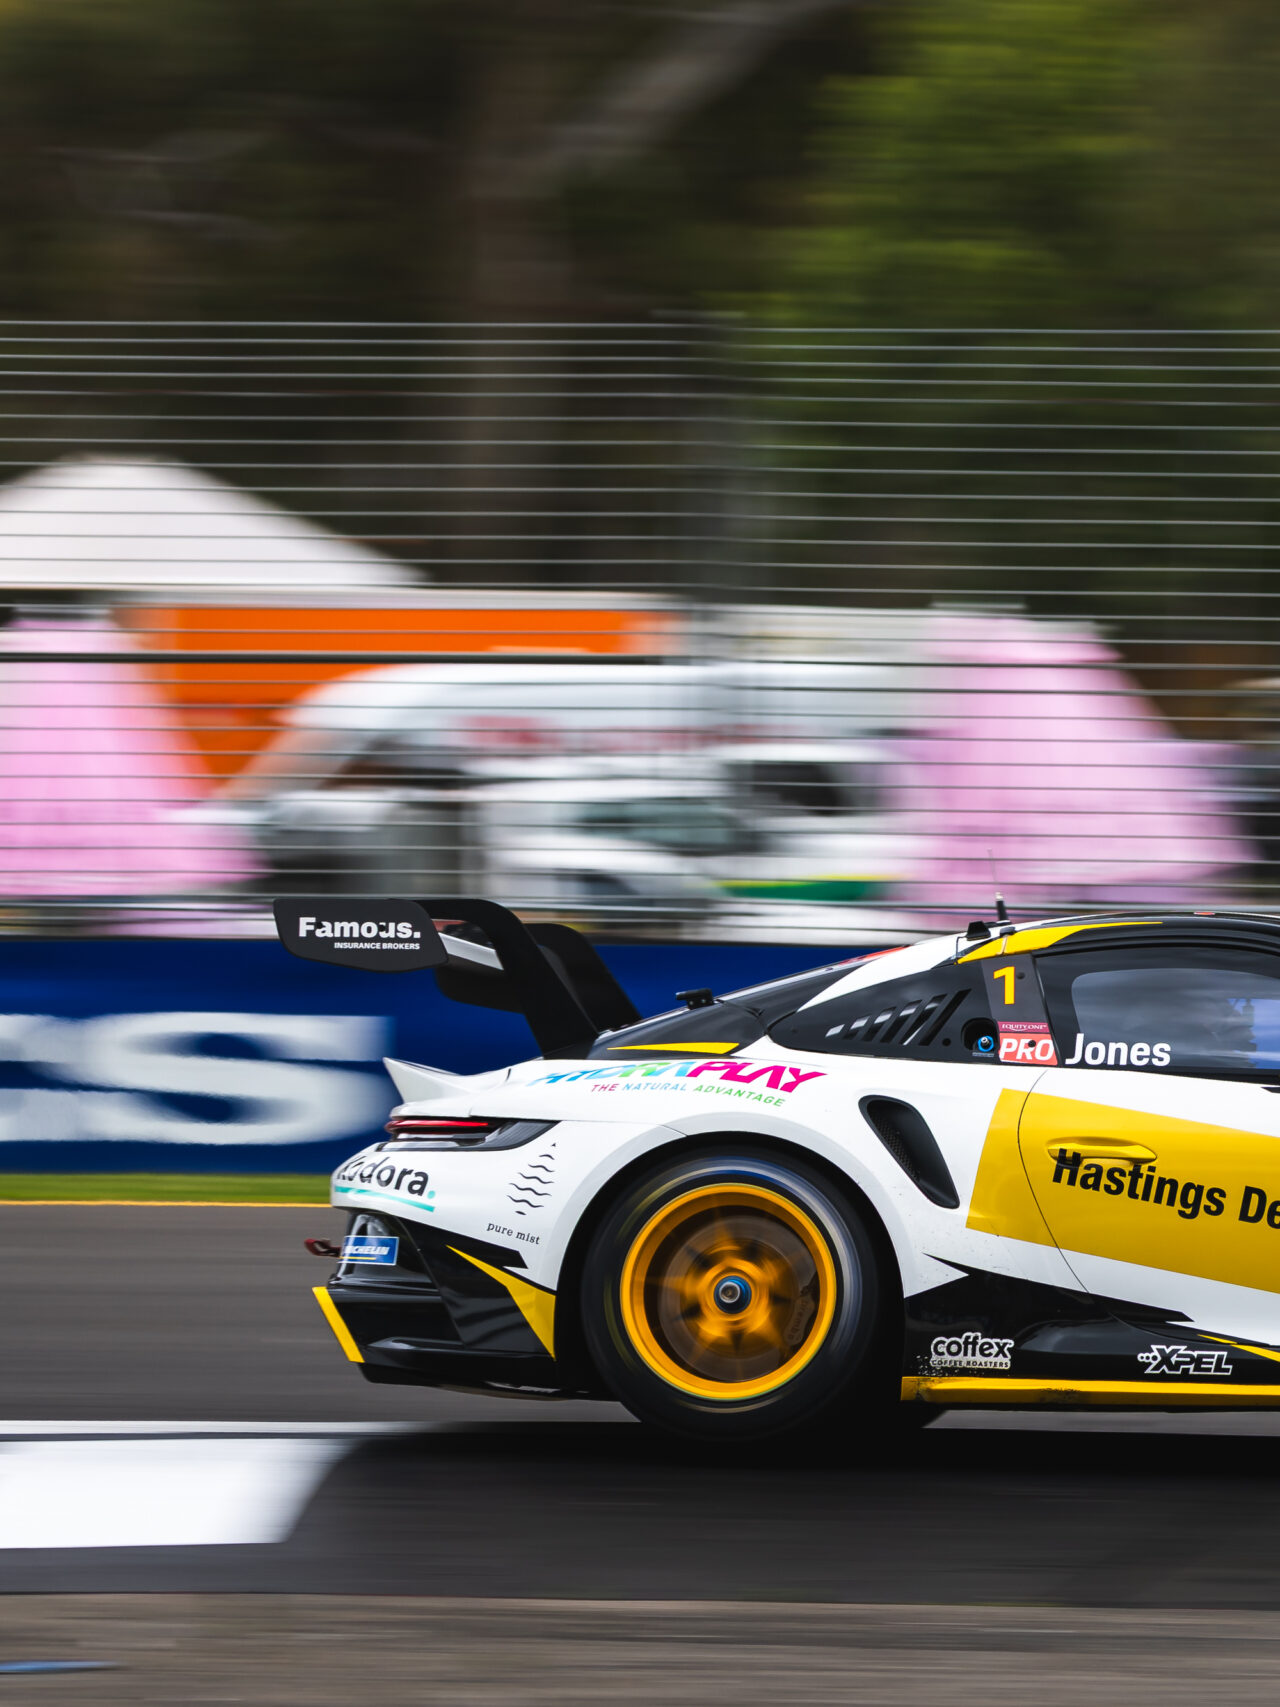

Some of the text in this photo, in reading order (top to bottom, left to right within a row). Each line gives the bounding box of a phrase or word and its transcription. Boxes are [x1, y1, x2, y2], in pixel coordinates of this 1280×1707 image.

[298, 916, 421, 938] Famous.
[993, 966, 1015, 1005] 1
[1000, 1038, 1054, 1061] PRO
[1065, 1033, 1171, 1067] Jones
[591, 1083, 787, 1107] THE NATURAL ADVANTAGE
[1052, 1149, 1227, 1219] Hastings
[487, 1222, 540, 1245] pure mist
[931, 1332, 1013, 1359] coffex
[931, 1359, 1010, 1369] COFFEE ROASTERS
[1143, 1345, 1233, 1375] XPEL
